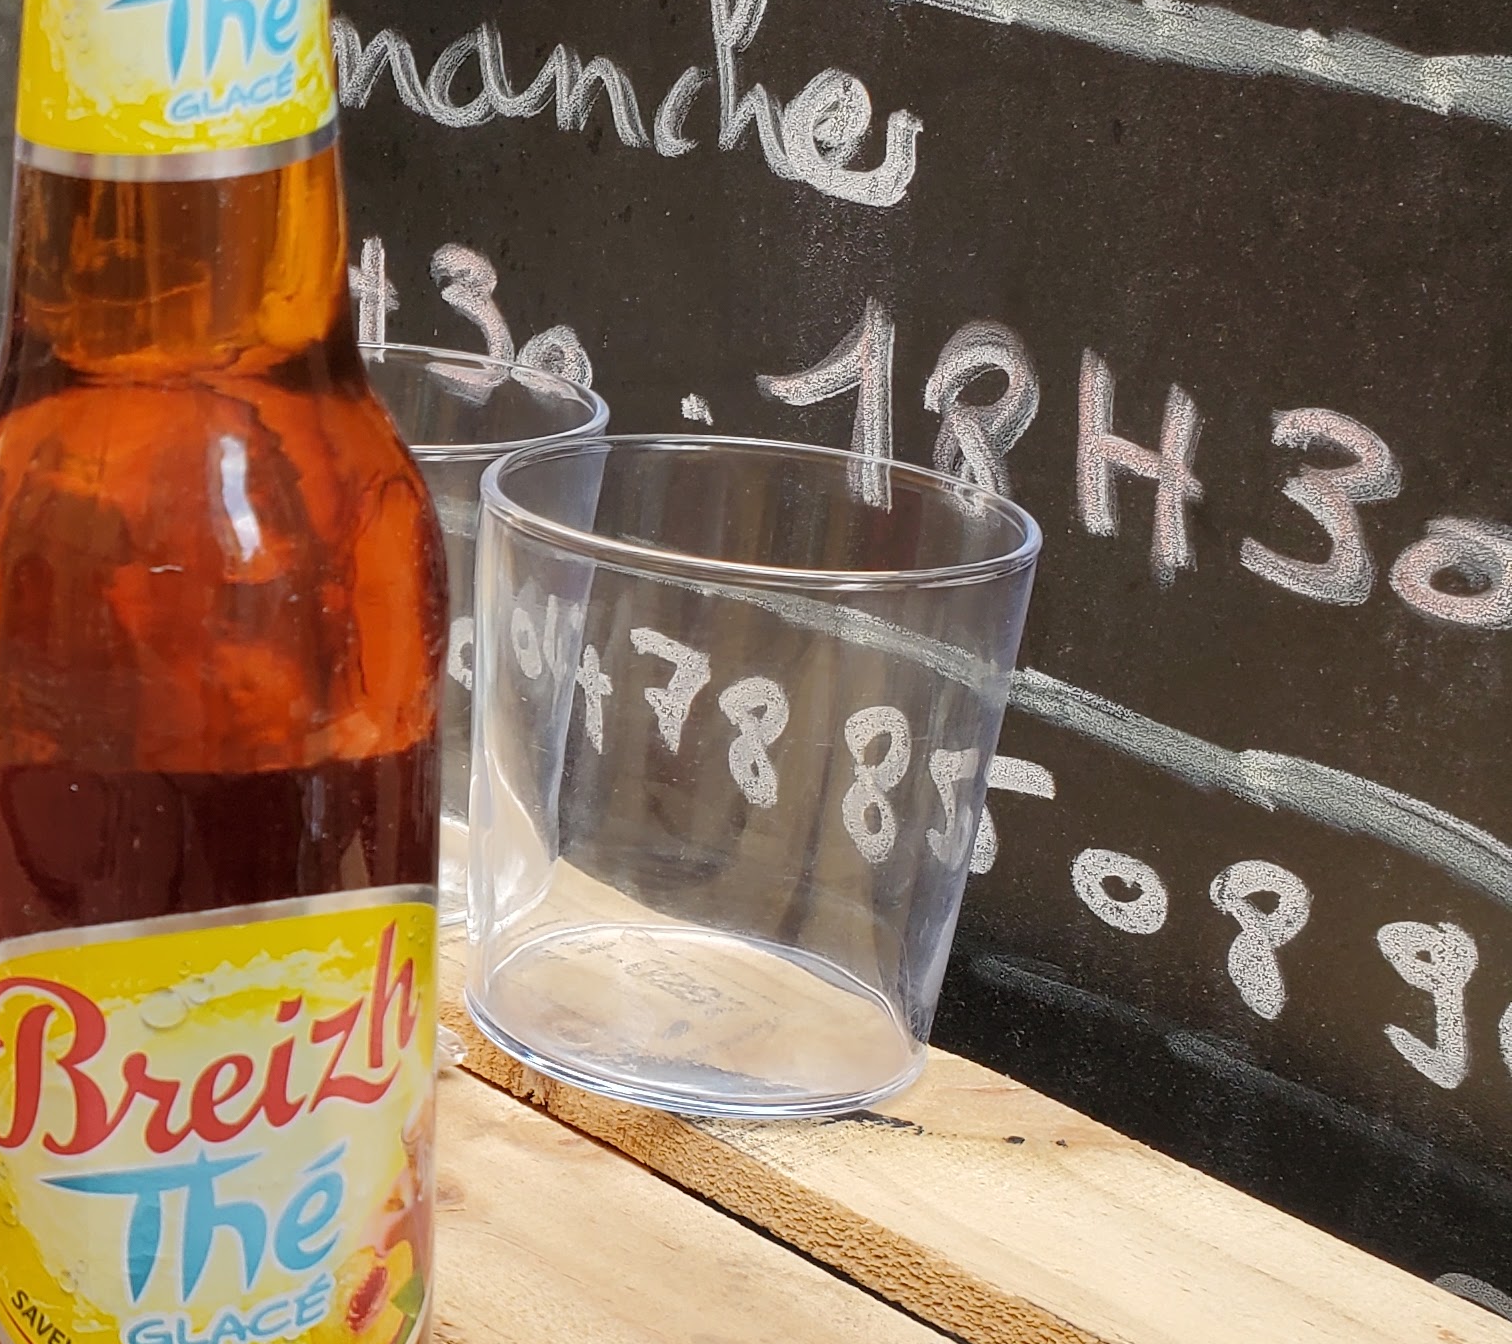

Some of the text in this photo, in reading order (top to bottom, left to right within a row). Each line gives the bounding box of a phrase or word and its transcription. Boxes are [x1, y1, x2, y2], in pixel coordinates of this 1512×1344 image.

[166, 63, 298, 123] GLACÉ
[1377, 920, 1512, 1090] 9
[39, 1140, 348, 1304] Thé
